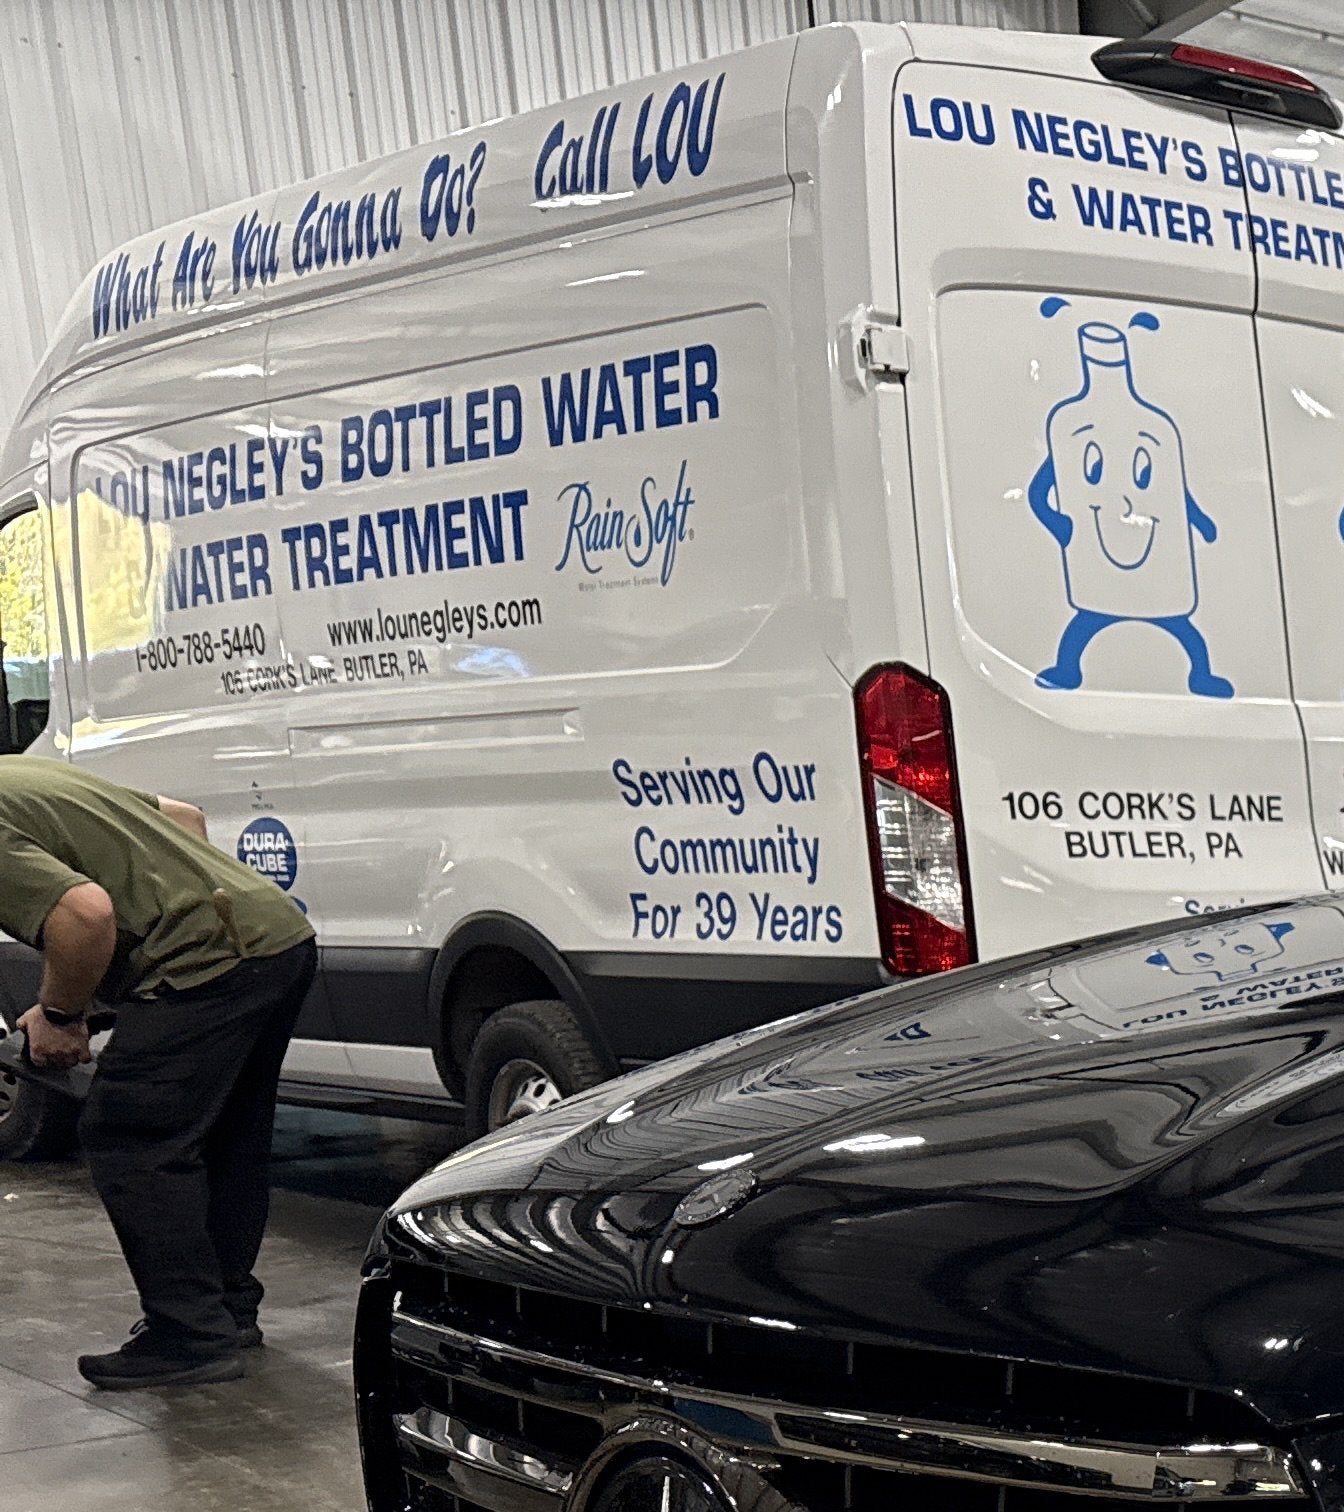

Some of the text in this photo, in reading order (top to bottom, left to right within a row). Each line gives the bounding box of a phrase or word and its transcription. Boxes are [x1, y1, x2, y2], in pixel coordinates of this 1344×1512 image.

[903, 93, 995, 146] LOU
[1011, 109, 1207, 182] NEGLEY'S
[93, 72, 726, 340] What Are You Gonna Do? Call LOU
[1027, 176, 1057, 221] &
[1072, 183, 1213, 247] WATER
[162, 425, 323, 519] NEGLEY'S
[340, 383, 523, 483] BOTTLED
[541, 343, 720, 447] WATER
[281, 488, 529, 591] TREATMENT
[135, 598, 543, 672] 1-800-788-5440 www.lounegleys.com
[221, 648, 429, 695] 106 CORK'S LANE BUTLER, PA
[612, 751, 816, 816] Serving Our
[1002, 790, 1284, 822] 106 CORK'S LANE
[246, 853, 289, 872] CUBE
[634, 824, 819, 885] Community
[1065, 830, 1243, 864] BUTLER, PA
[629, 891, 843, 943] For 39 Years
